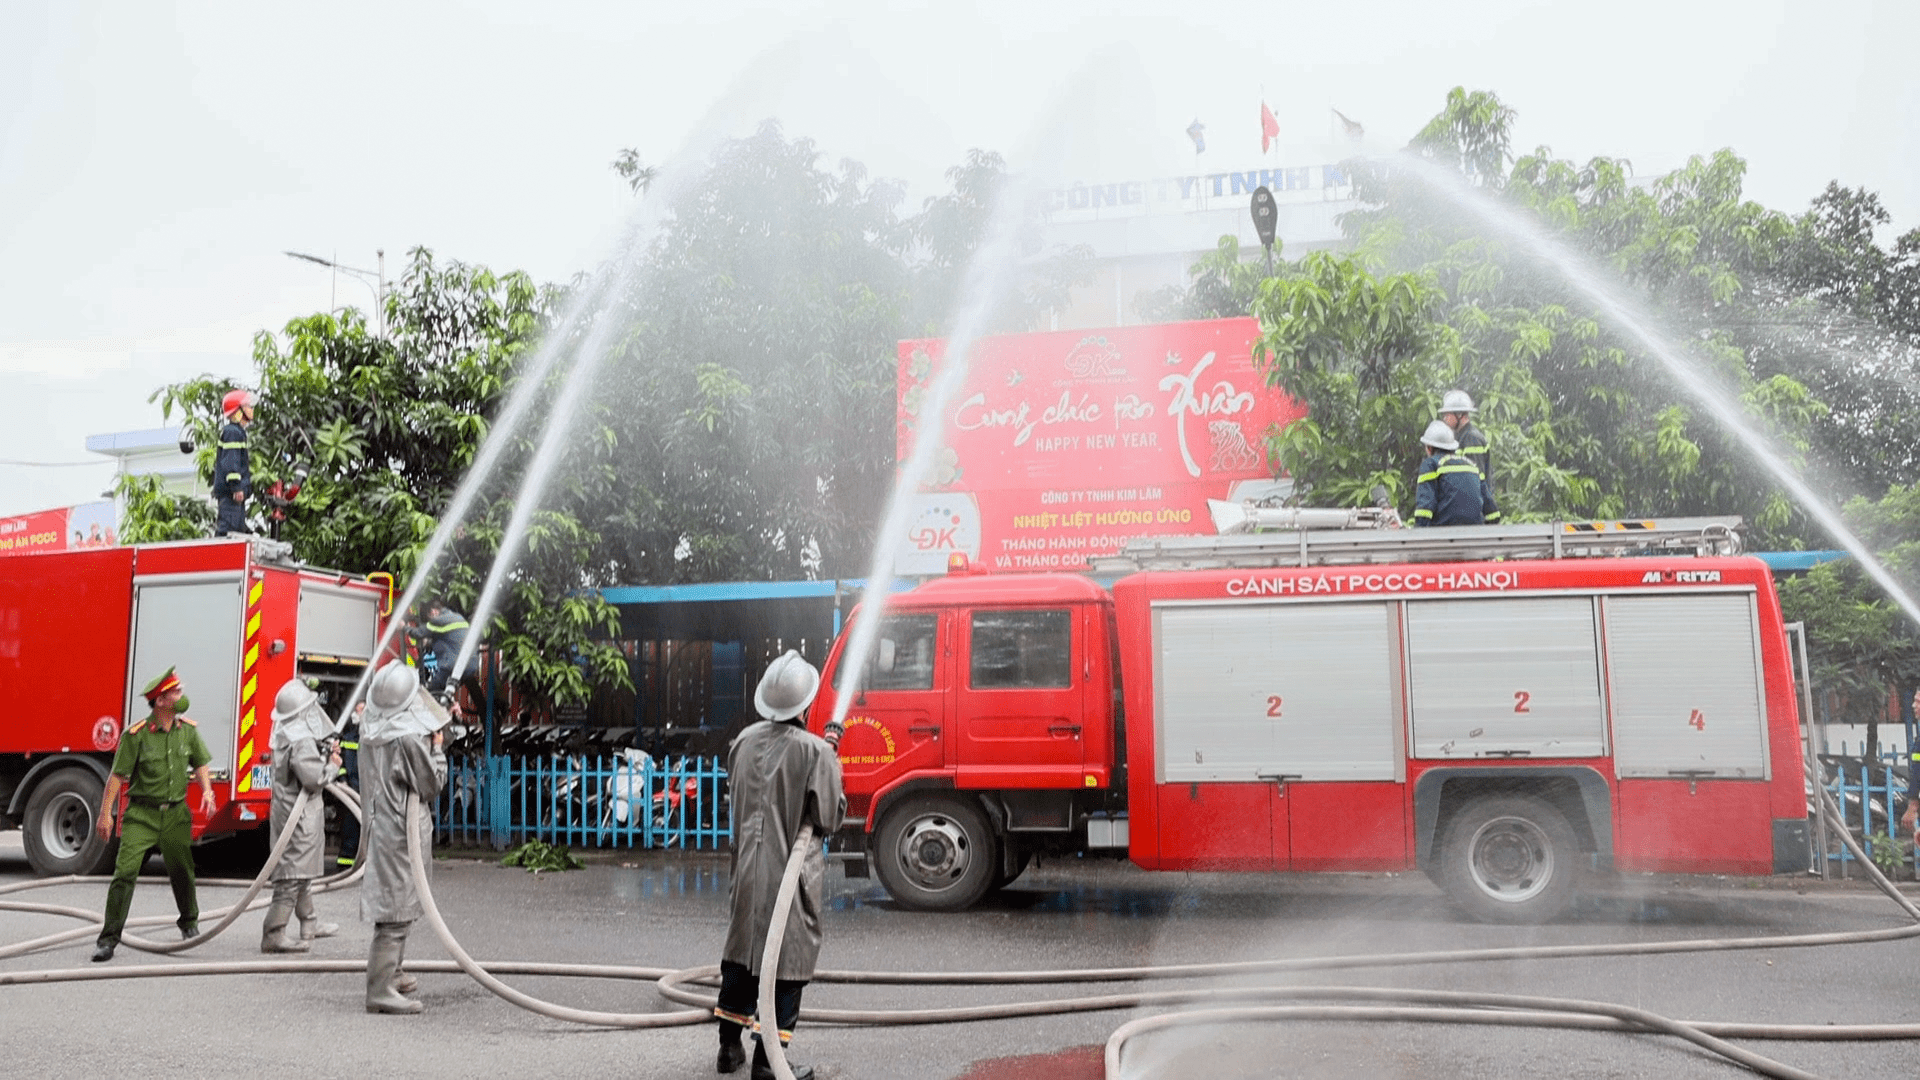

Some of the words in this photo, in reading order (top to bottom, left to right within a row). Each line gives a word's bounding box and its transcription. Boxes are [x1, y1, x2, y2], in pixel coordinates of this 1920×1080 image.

[1208, 167, 1309, 196] TNHH
[954, 391, 1036, 447] Cung
[1042, 390, 1102, 424] chúc
[1159, 351, 1255, 477] Xuân
[1035, 436, 1080, 452] HAPPY
[1086, 434, 1116, 450] NEW
[1122, 432, 1158, 447] YEAR
[1041, 490, 1068, 504] CÔNG
[1071, 491, 1083, 502] TY
[1086, 490, 1114, 502] TNHH
[1117, 489, 1136, 501] KIM
[1139, 487, 1162, 500] LÂM
[1014, 511, 1059, 529] NHIỆT
[1061, 511, 1093, 529] LIỆT
[1096, 508, 1153, 525] HƯỞNG
[1156, 508, 1192, 523] ỨNG
[31, 531, 56, 545] PCCC
[1001, 536, 1046, 551] THÁNG
[1049, 535, 1087, 549] HÀNH
[1090, 534, 1128, 550] ĐỘNG
[995, 554, 1012, 567] VÀ
[1015, 553, 1059, 567] THÁNG
[1062, 552, 1097, 566] CÔN
[1642, 569, 1721, 583] MORITA
[1267, 695, 1282, 717] 2
[1514, 691, 1530, 713] 2
[1689, 709, 1705, 731] 4
